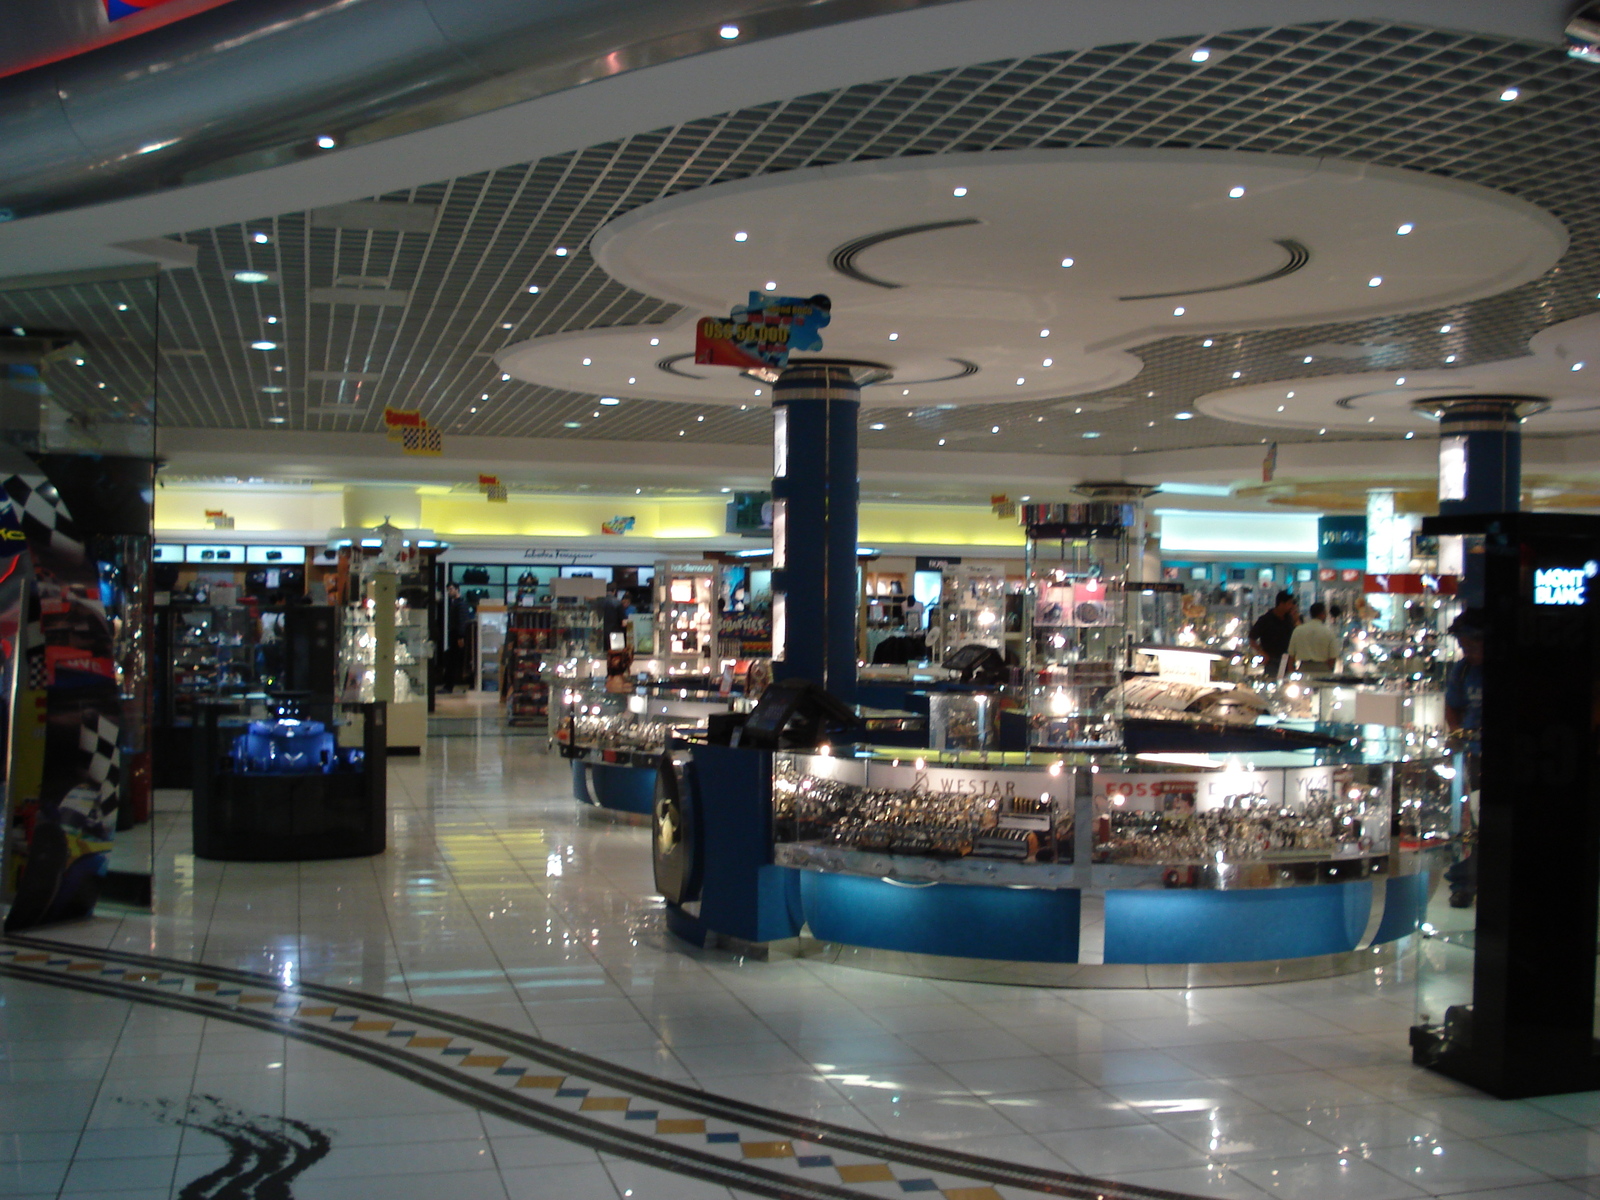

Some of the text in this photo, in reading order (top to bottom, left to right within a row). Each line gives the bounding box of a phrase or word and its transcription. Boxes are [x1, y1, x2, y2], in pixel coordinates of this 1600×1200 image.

[1534, 568, 1586, 588] MONT
[1534, 586, 1586, 606] BLANC
[940, 777, 1016, 797] WESTAR
